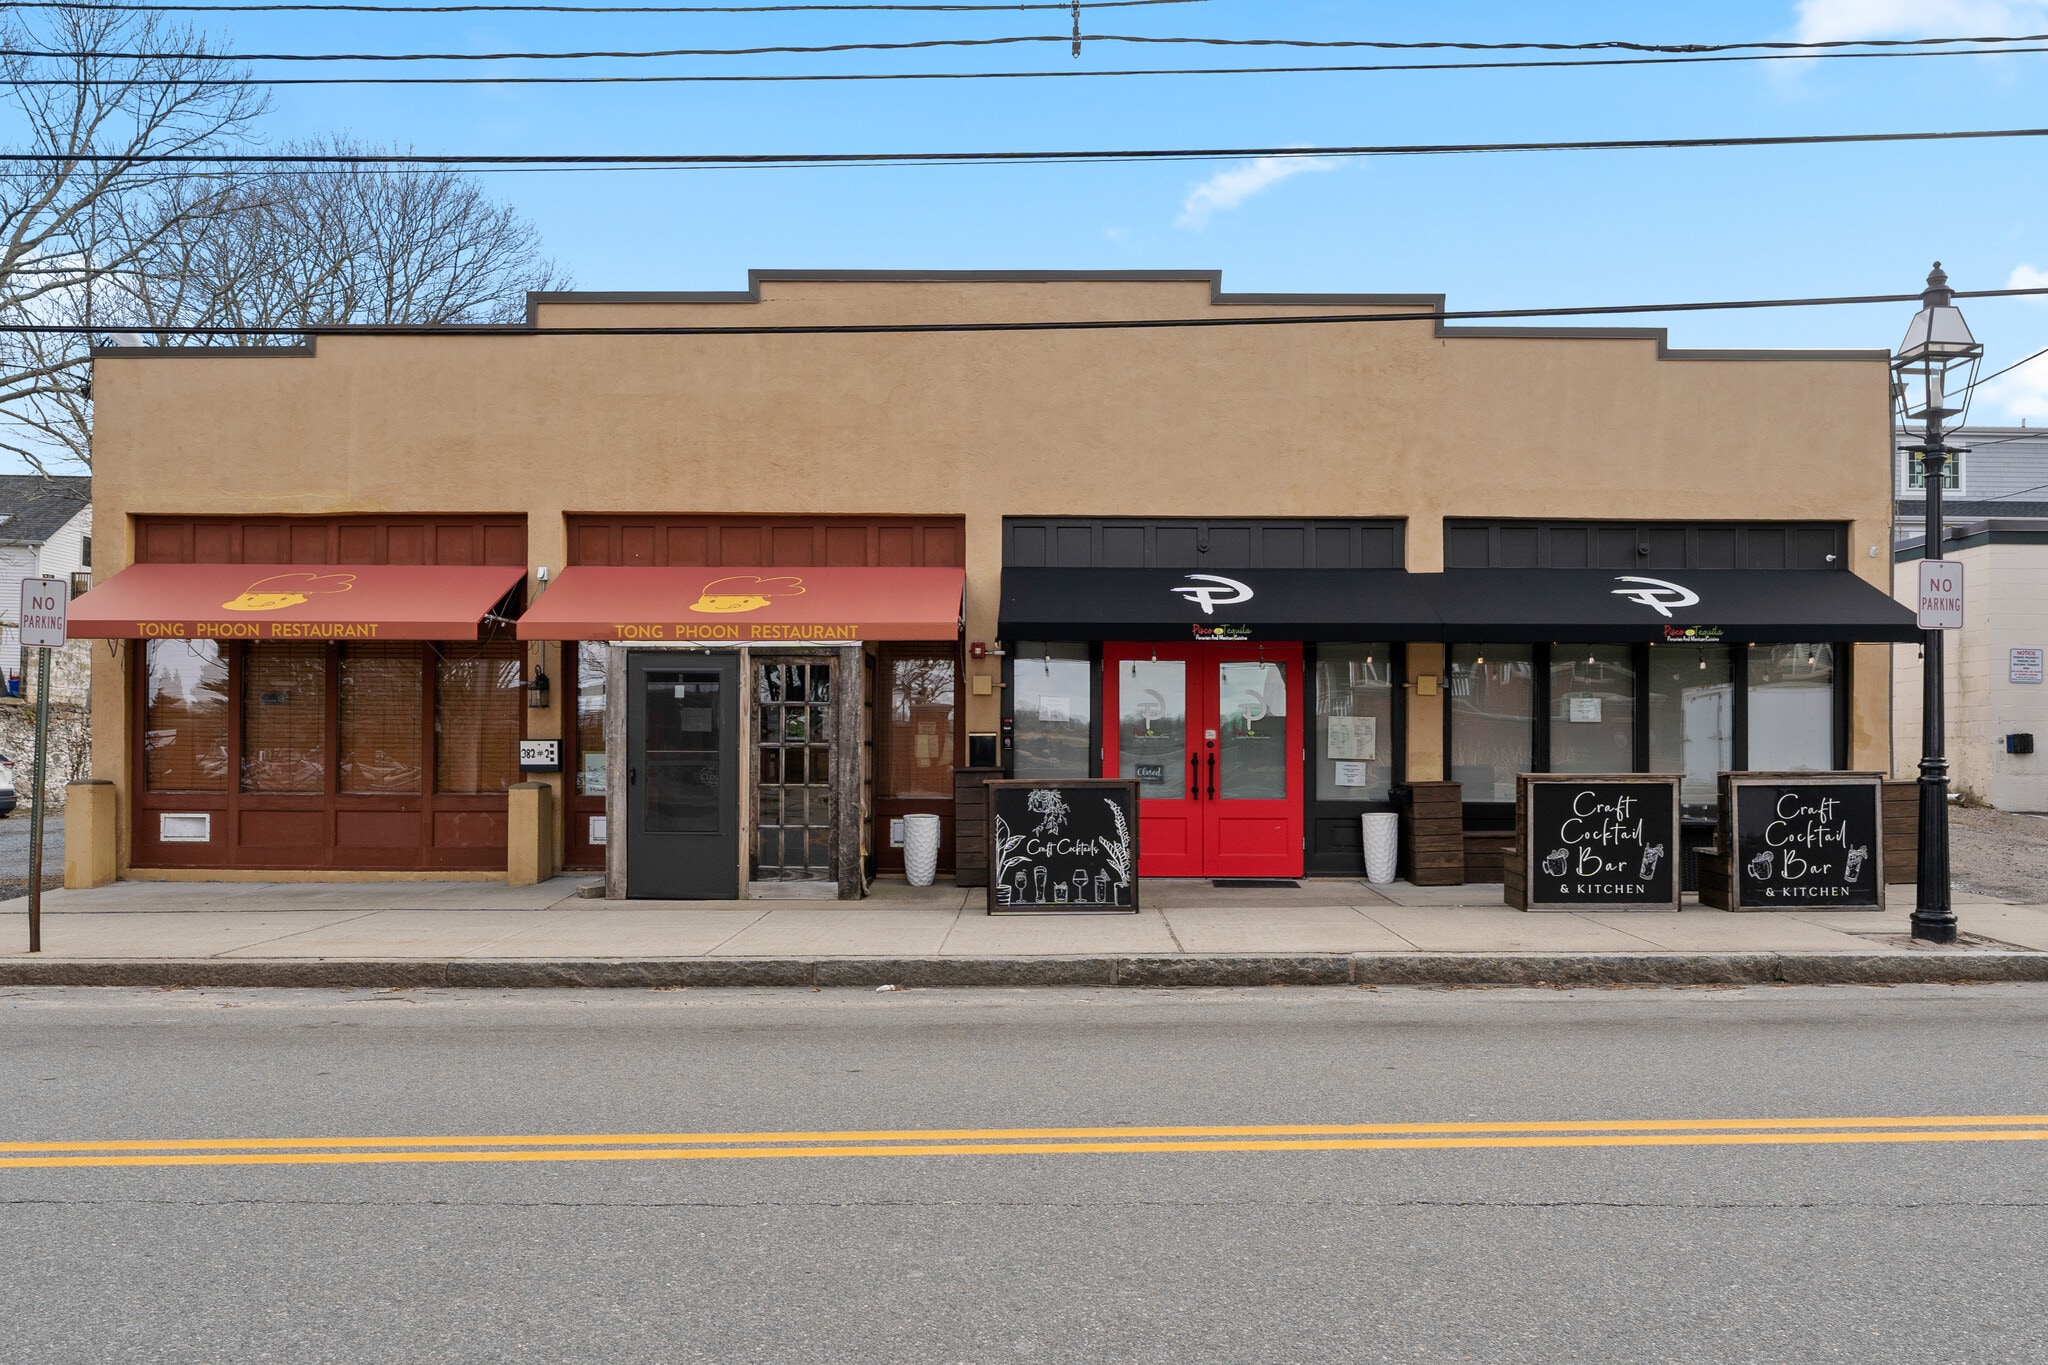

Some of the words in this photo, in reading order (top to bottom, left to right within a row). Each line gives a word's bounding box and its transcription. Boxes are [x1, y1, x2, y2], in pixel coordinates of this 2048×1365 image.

[1930, 578, 1953, 592] NO
[32, 596, 55, 611] NO
[1921, 597, 1961, 612] PARKING
[23, 614, 63, 630] PARKING
[1192, 623, 1213, 635] Pisco
[1220, 624, 1252, 636] Tequila
[136, 622, 185, 638] TONG
[196, 623, 260, 638] PHOON
[271, 623, 379, 638] RESTAURANT
[615, 624, 664, 639] TONG
[675, 624, 739, 639] PHOON
[751, 624, 859, 639] RESTAURANT
[1663, 624, 1685, 637] Pisco
[1691, 625, 1724, 637] Tequila
[521, 749, 535, 759] 382
[1137, 767, 1162, 777] Closed
[1573, 791, 1638, 822] Craft
[1776, 793, 1841, 824] Craft
[1560, 818, 1643, 847] Cocktail
[1765, 819, 1847, 849] Cocktail
[1026, 838, 1056, 857] Craft
[1056, 838, 1100, 857] Cocktails
[1576, 846, 1628, 877] Bar
[1781, 849, 1832, 880] Bar
[1559, 884, 1570, 894] &
[1577, 884, 1645, 894] KITCHEN
[1765, 887, 1775, 897] &
[1783, 886, 1850, 897] KITCHEN
